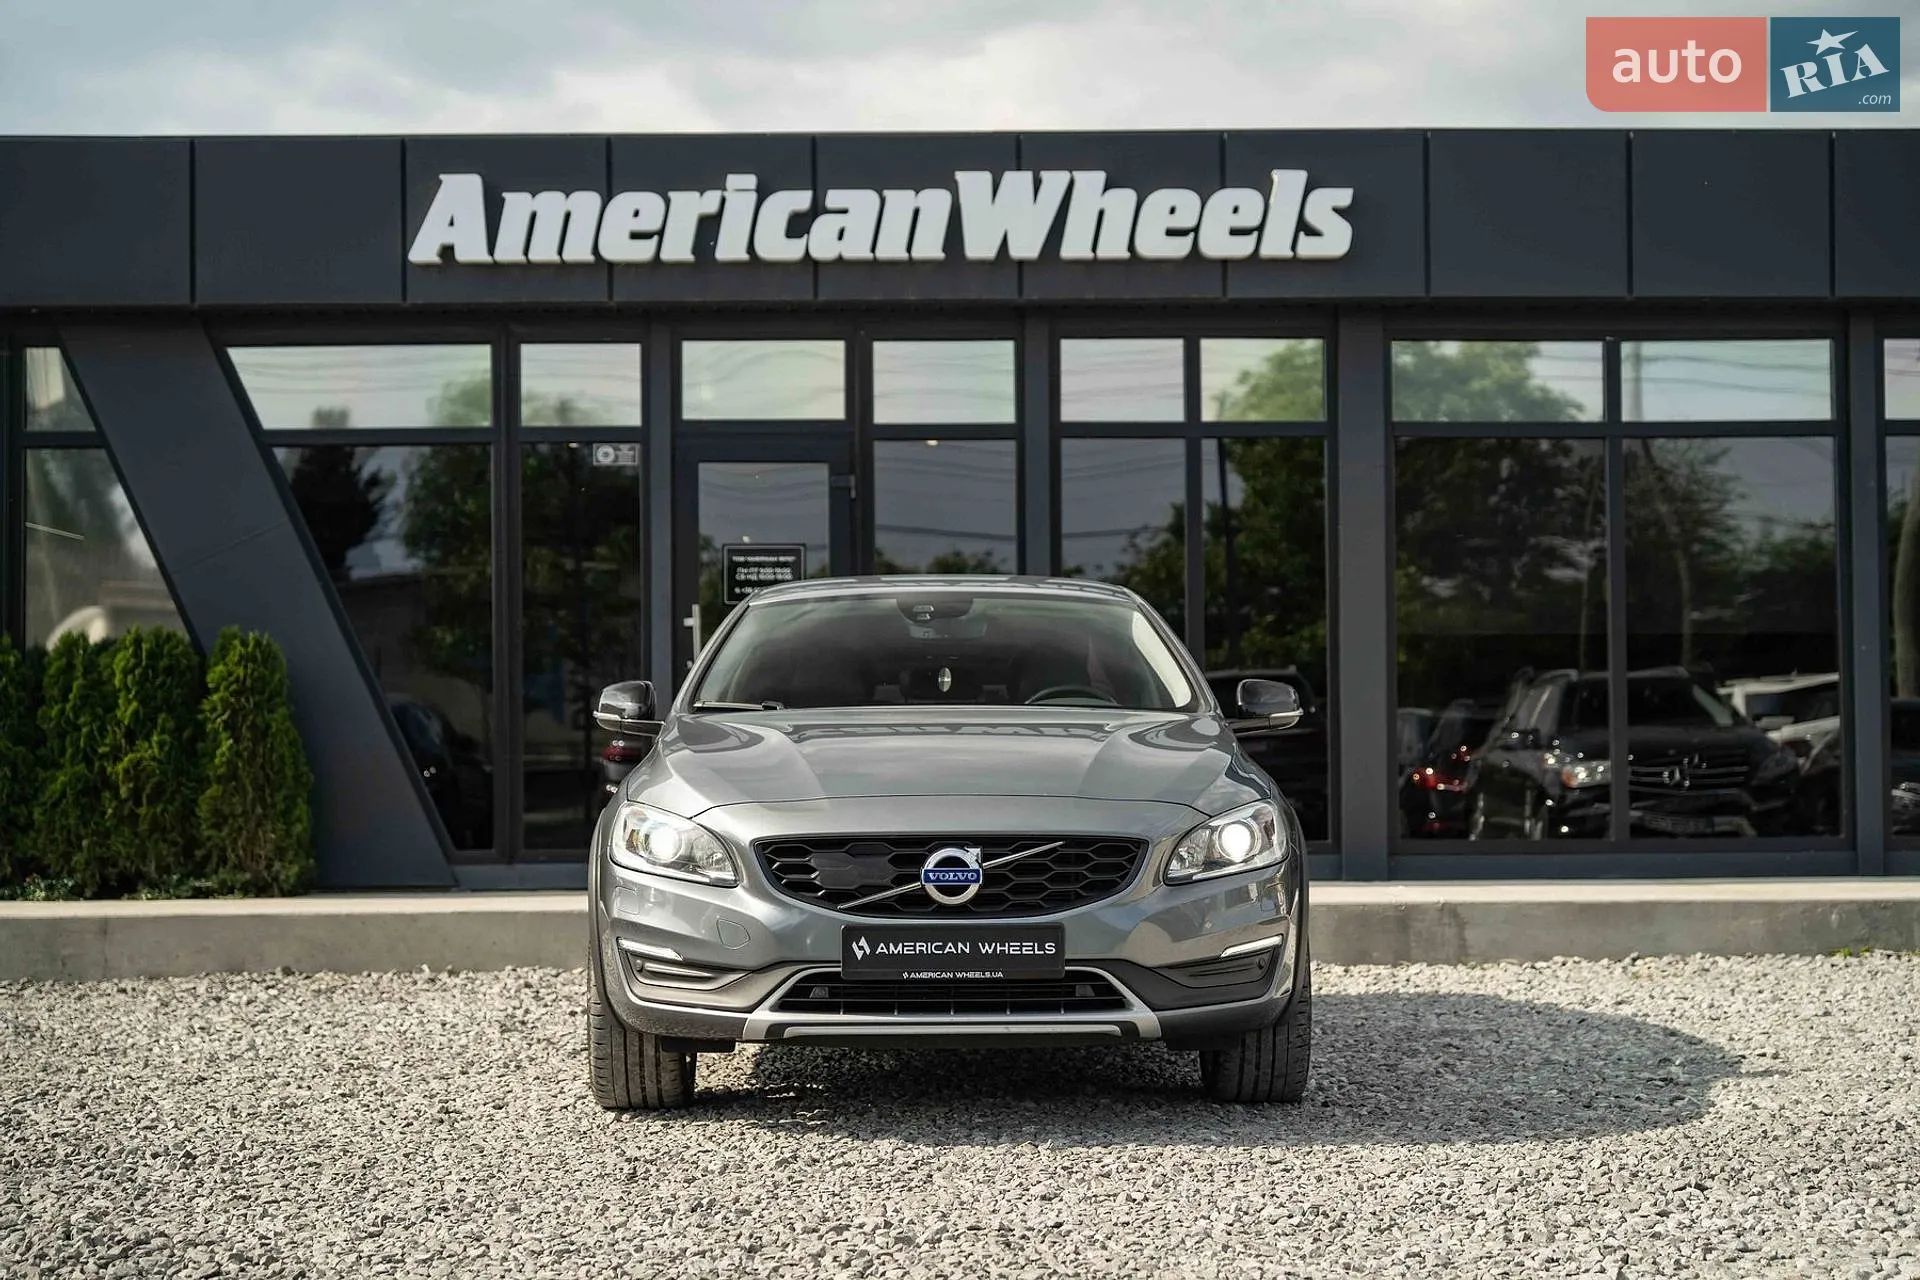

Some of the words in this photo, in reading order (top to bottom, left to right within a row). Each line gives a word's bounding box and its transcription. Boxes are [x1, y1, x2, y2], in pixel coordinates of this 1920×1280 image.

[408, 169, 1354, 263] AmericanWheels
[927, 872, 978, 881] VOLVO
[875, 942, 970, 955] AMERICAN
[978, 942, 1056, 955] WHEELS
[909, 971, 953, 979] AMERICAN
[955, 971, 1004, 979] WHEELS.UA
